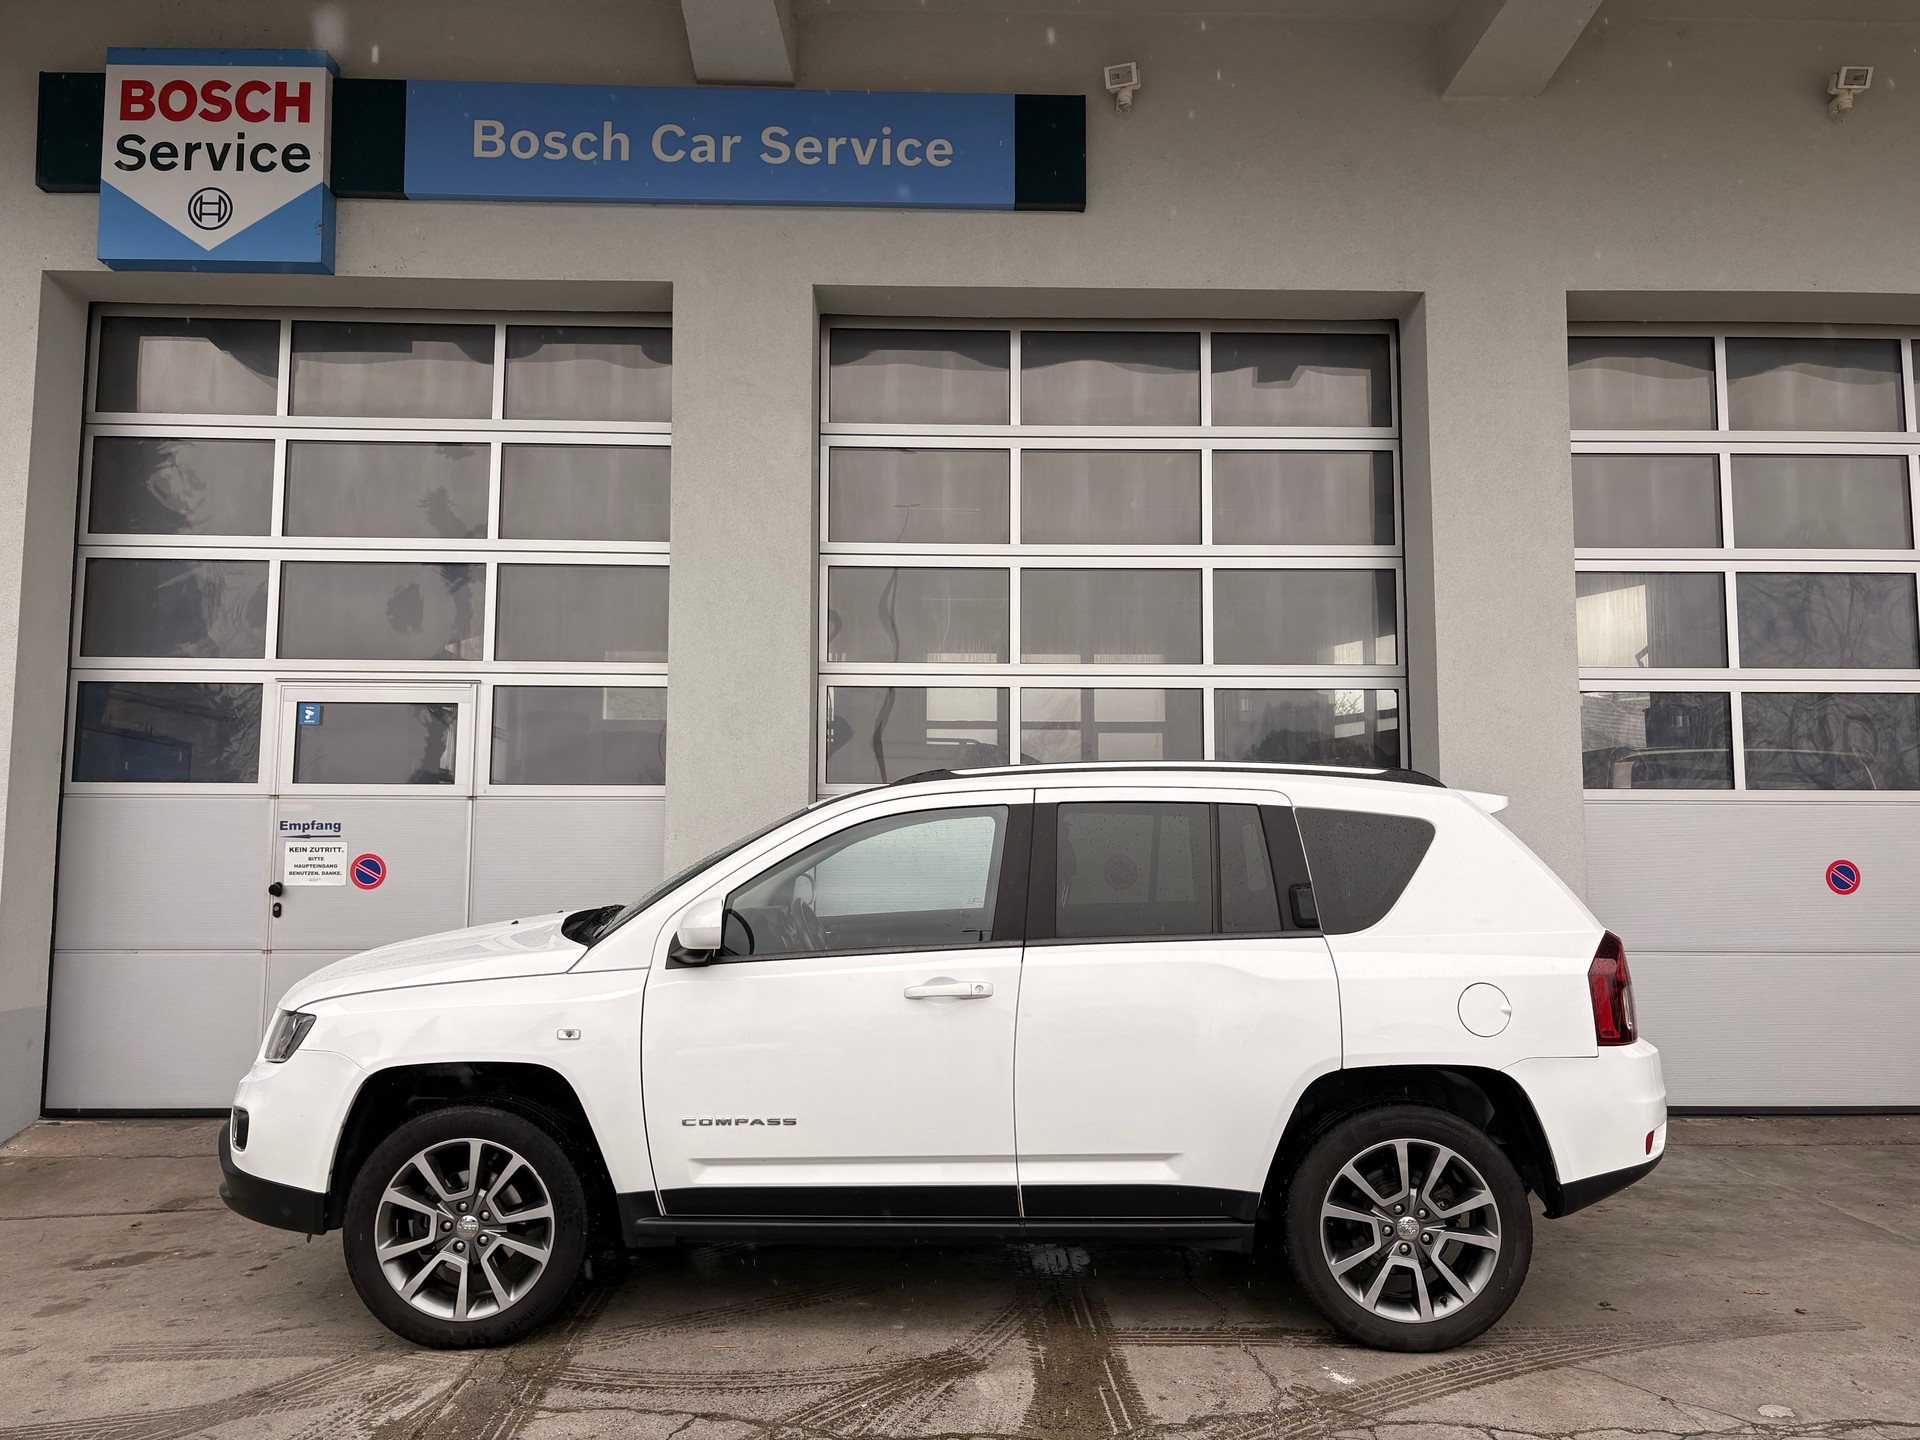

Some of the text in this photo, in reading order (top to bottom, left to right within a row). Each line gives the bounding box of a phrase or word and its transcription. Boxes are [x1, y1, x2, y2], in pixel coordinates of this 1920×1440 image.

[119, 79, 311, 123] BOSCH
[114, 131, 311, 173] Service
[472, 119, 954, 167] Bosch Car Service
[279, 820, 342, 833] Empfang
[681, 1117, 797, 1127] COMPASS
